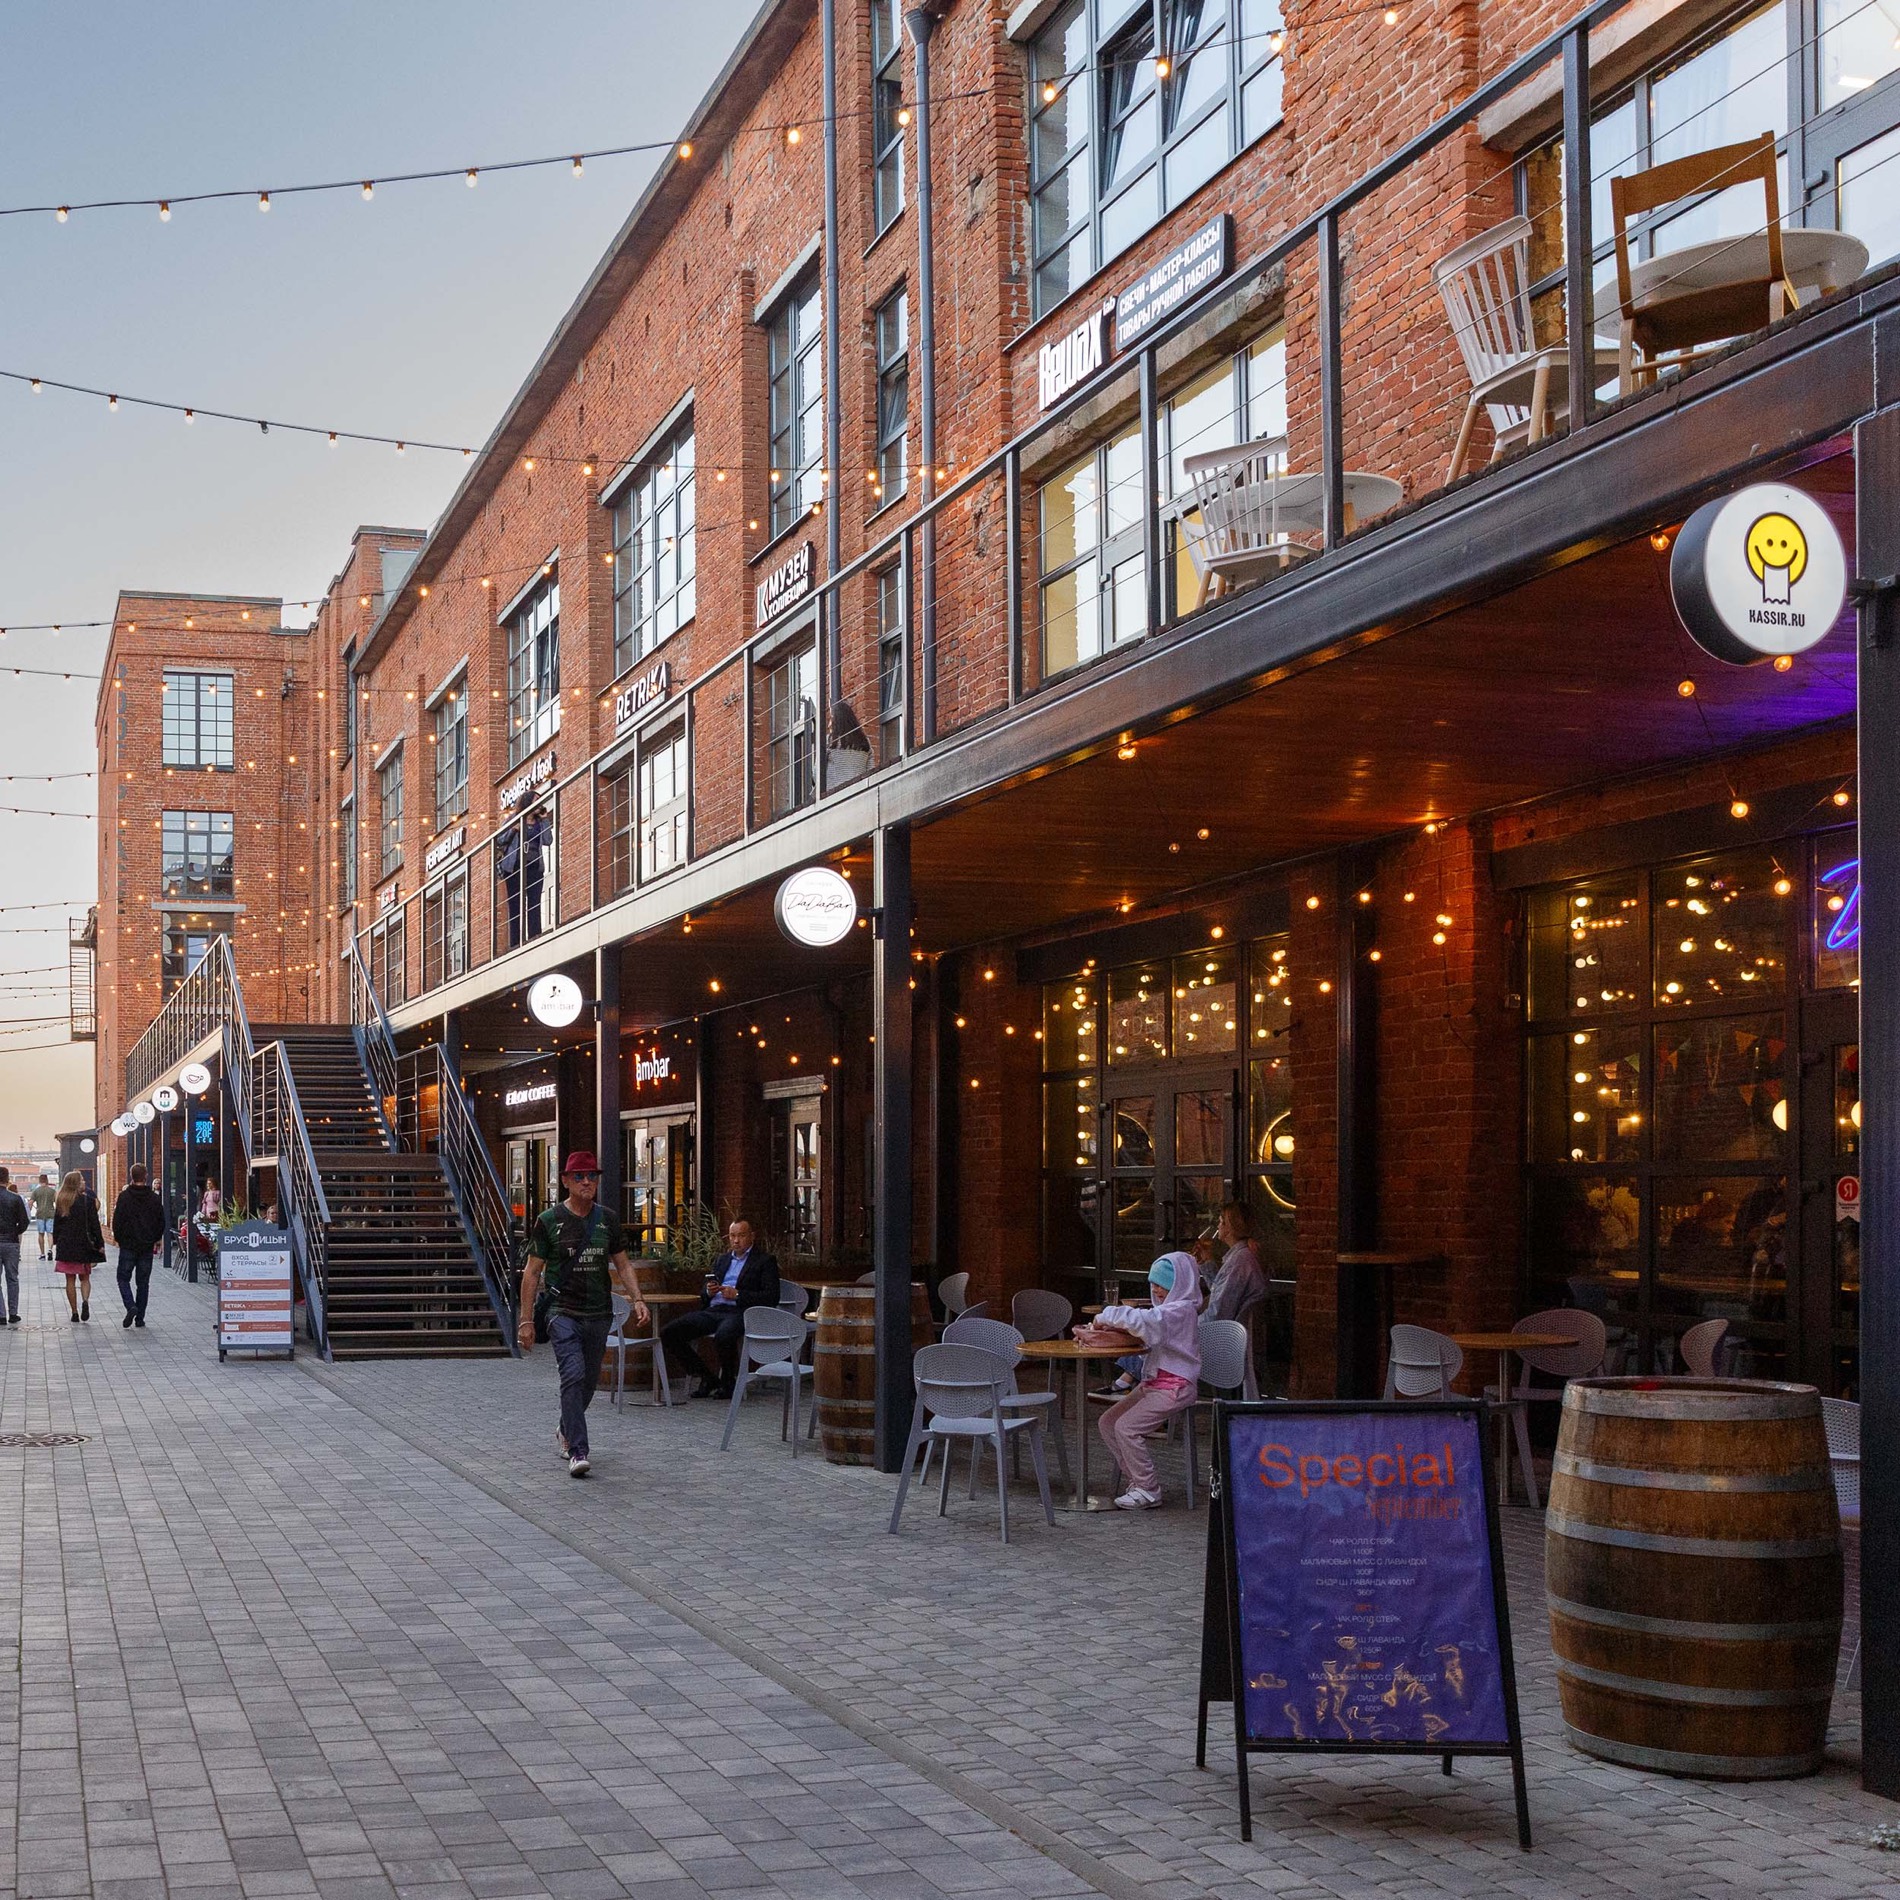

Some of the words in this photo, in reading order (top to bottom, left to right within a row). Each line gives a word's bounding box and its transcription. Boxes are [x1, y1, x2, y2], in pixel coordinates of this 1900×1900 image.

[1118, 304, 1150, 343] ТОВАРЫ
[1151, 275, 1184, 319] РУЧНОЙ
[1184, 249, 1220, 293] РАБОТЫ
[1119, 282, 1145, 317] СВЕЧИ
[1149, 221, 1220, 294] МАСТЕР-КЛАССЫ
[768, 540, 809, 601] МУЗЕЙ
[1749, 609, 1806, 627] KASSIR.RU
[616, 661, 667, 725] RETRIKA
[528, 1083, 557, 1101] COFFEE
[1259, 1442, 1455, 1499] Special
